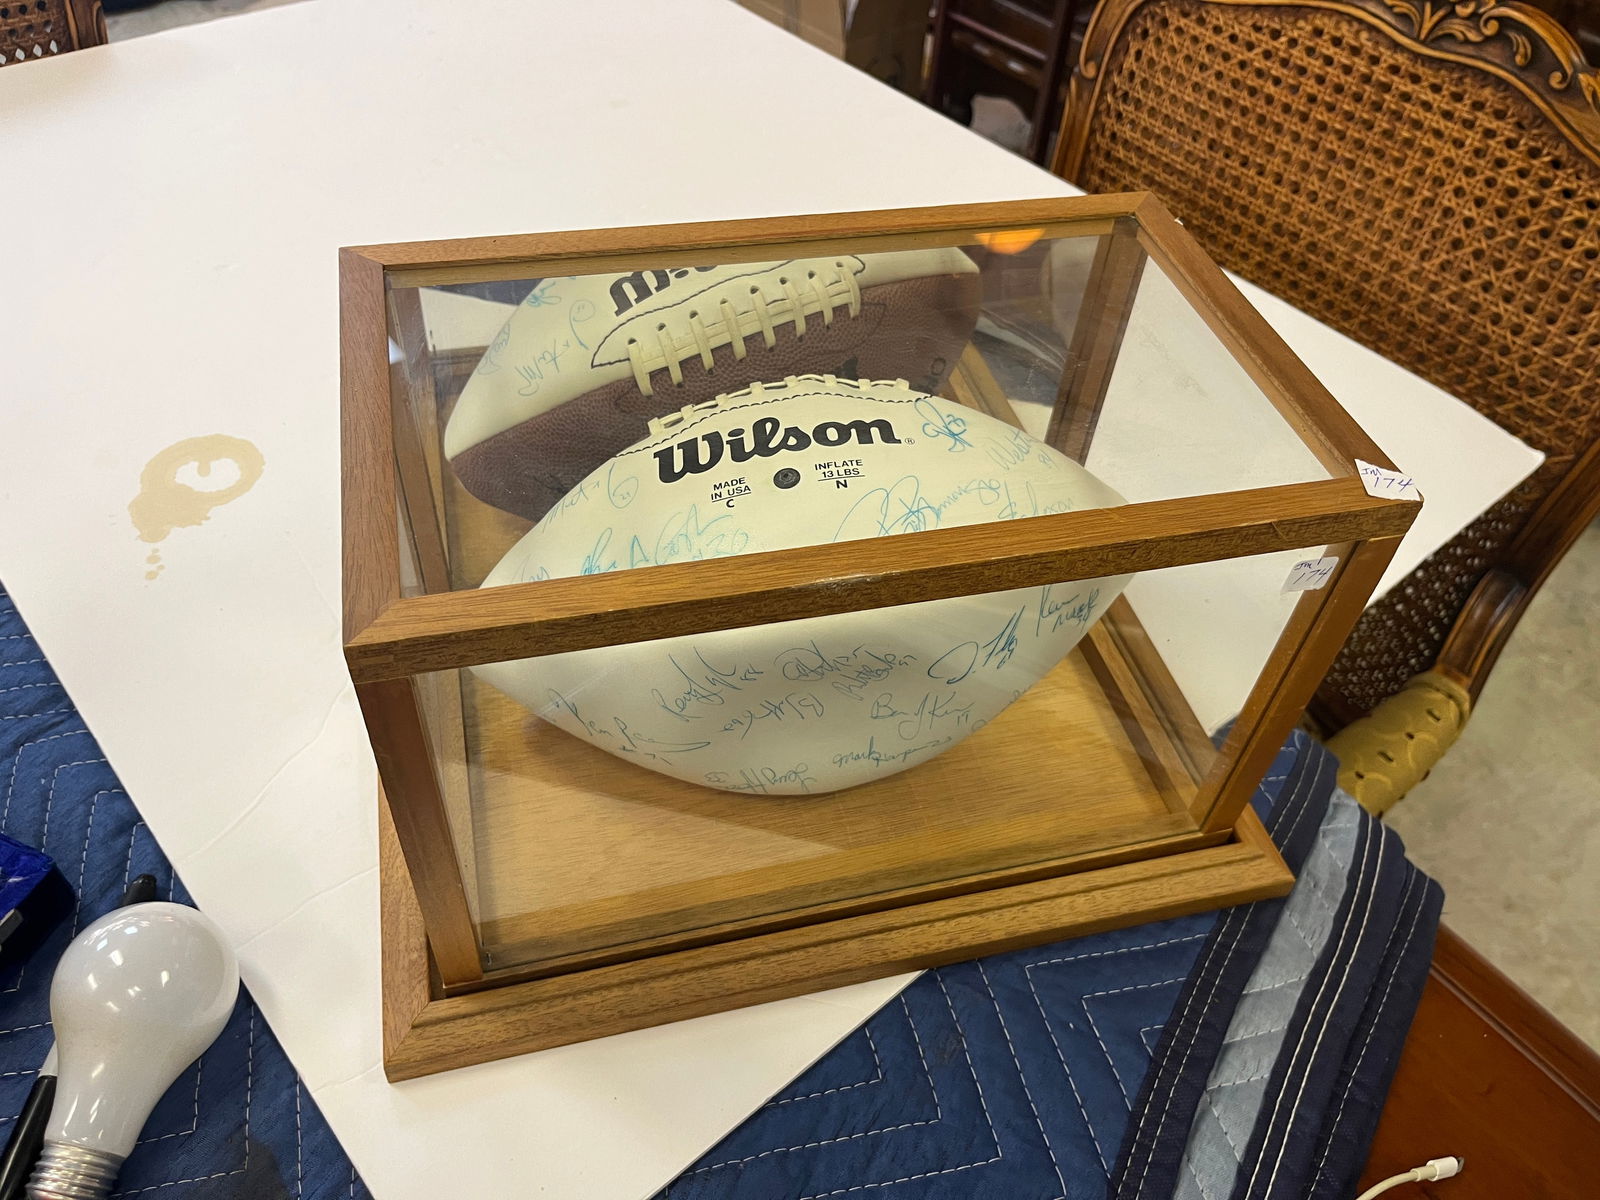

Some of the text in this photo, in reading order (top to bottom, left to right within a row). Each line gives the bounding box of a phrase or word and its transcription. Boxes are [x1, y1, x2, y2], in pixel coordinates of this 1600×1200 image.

[653, 417, 902, 483] Wilson
[814, 459, 863, 470] INFLATE
[837, 468, 860, 476] LBS
[713, 477, 746, 491] MADE
[836, 480, 848, 489] N
[711, 485, 752, 501] IN USA
[726, 499, 735, 508] C
